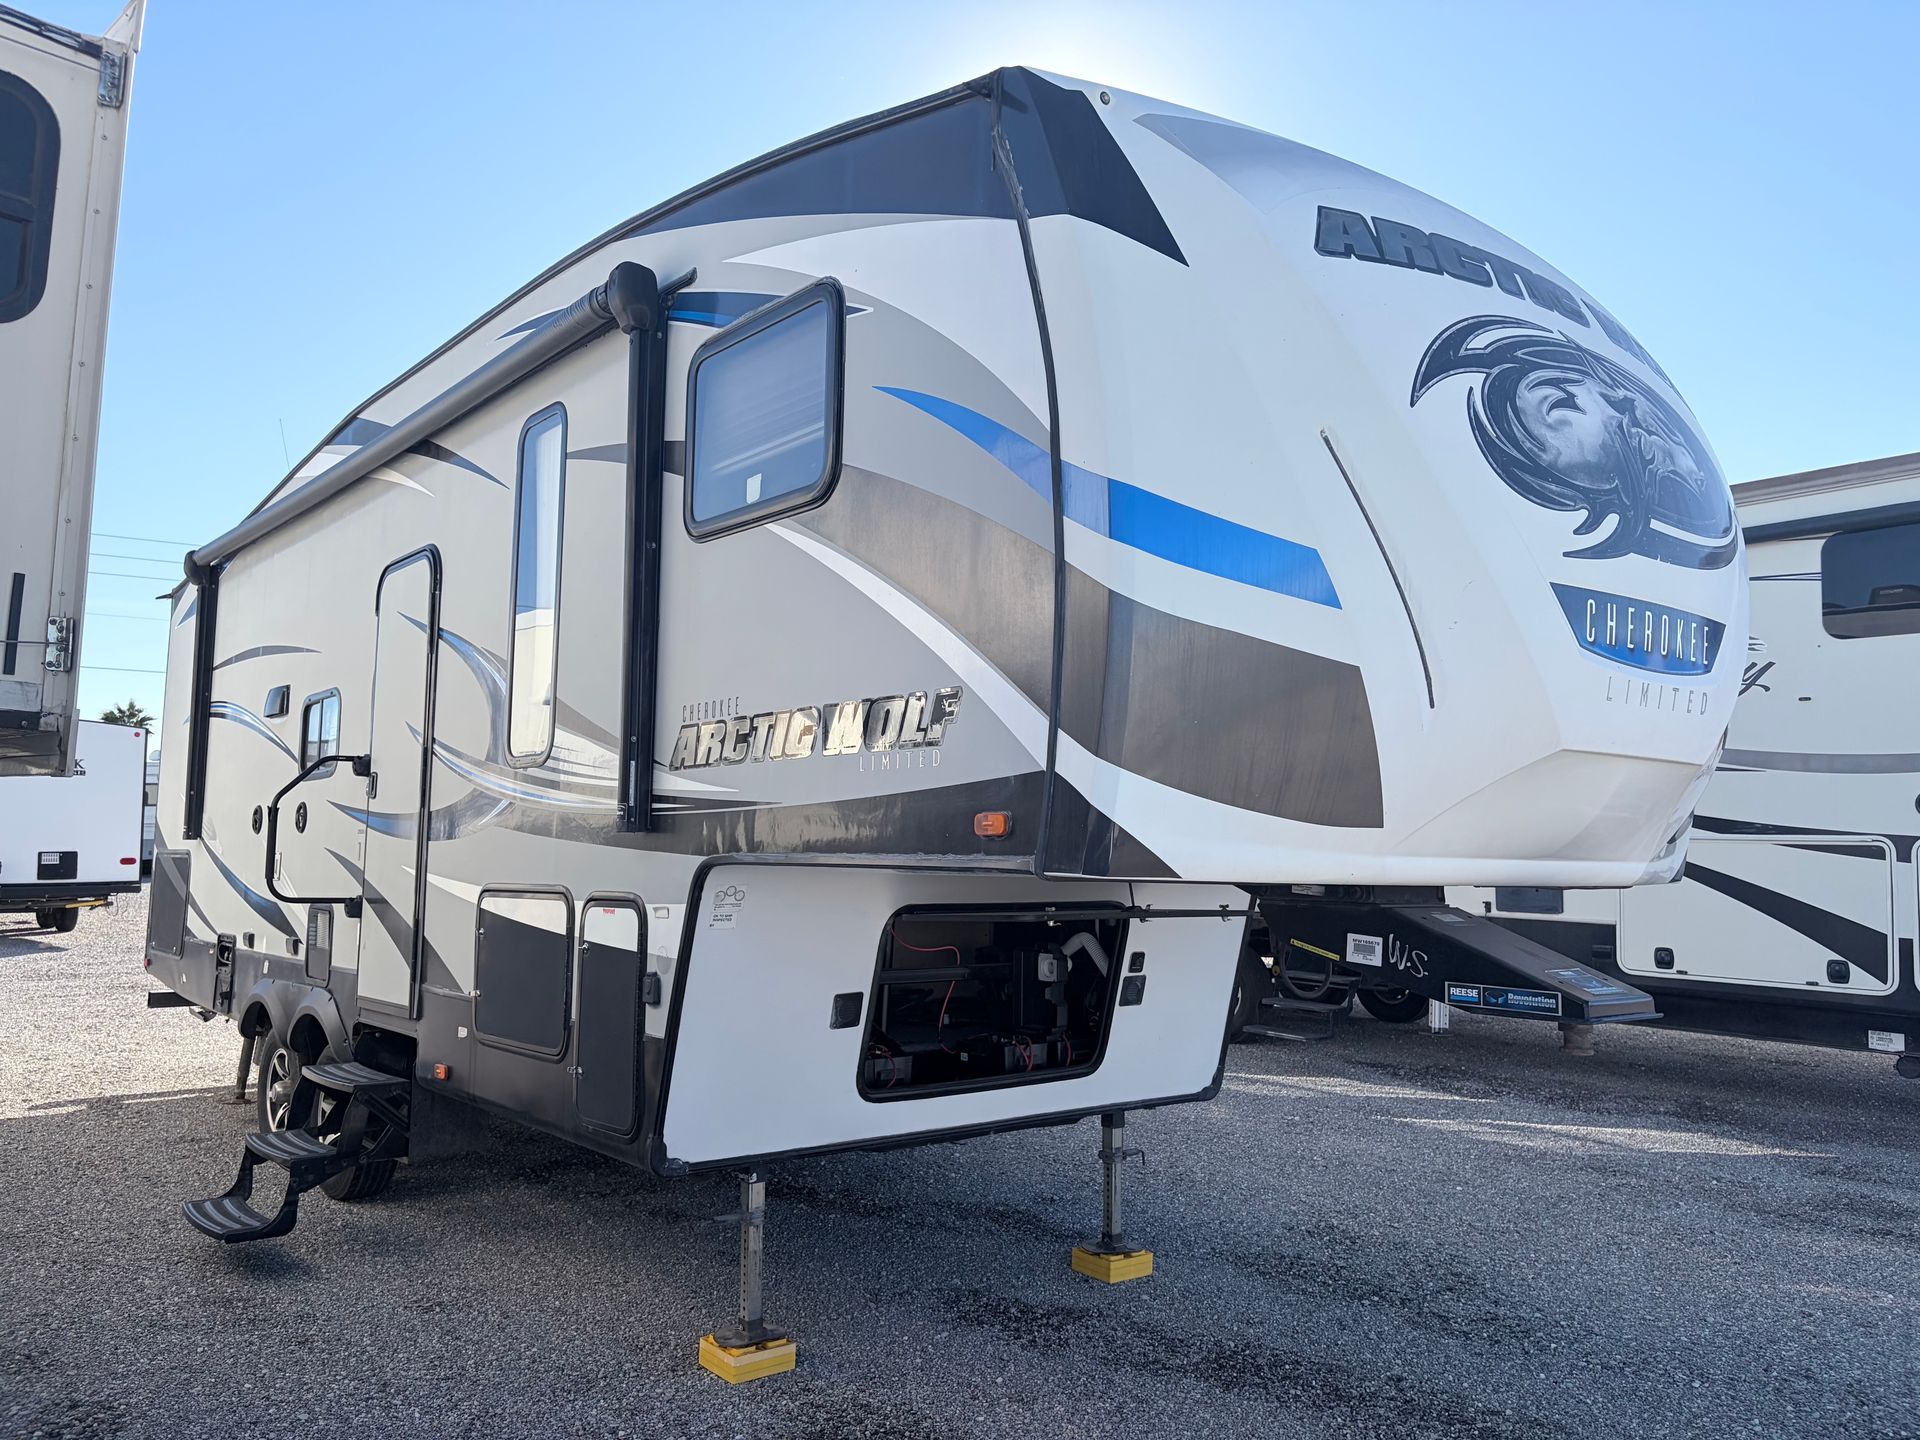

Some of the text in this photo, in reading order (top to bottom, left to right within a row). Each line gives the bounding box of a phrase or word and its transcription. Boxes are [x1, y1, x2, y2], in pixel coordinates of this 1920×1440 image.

[1314, 205, 1590, 328] ARCTIC
[1586, 598, 1710, 665] CHEROKEE
[682, 696, 740, 723] CHEROKEE
[1606, 675, 1708, 715] LIMITED
[669, 685, 963, 771] ARCTIC WOLF
[858, 750, 942, 772] LIMITED
[1450, 987, 1556, 1009] REESE Revolution
